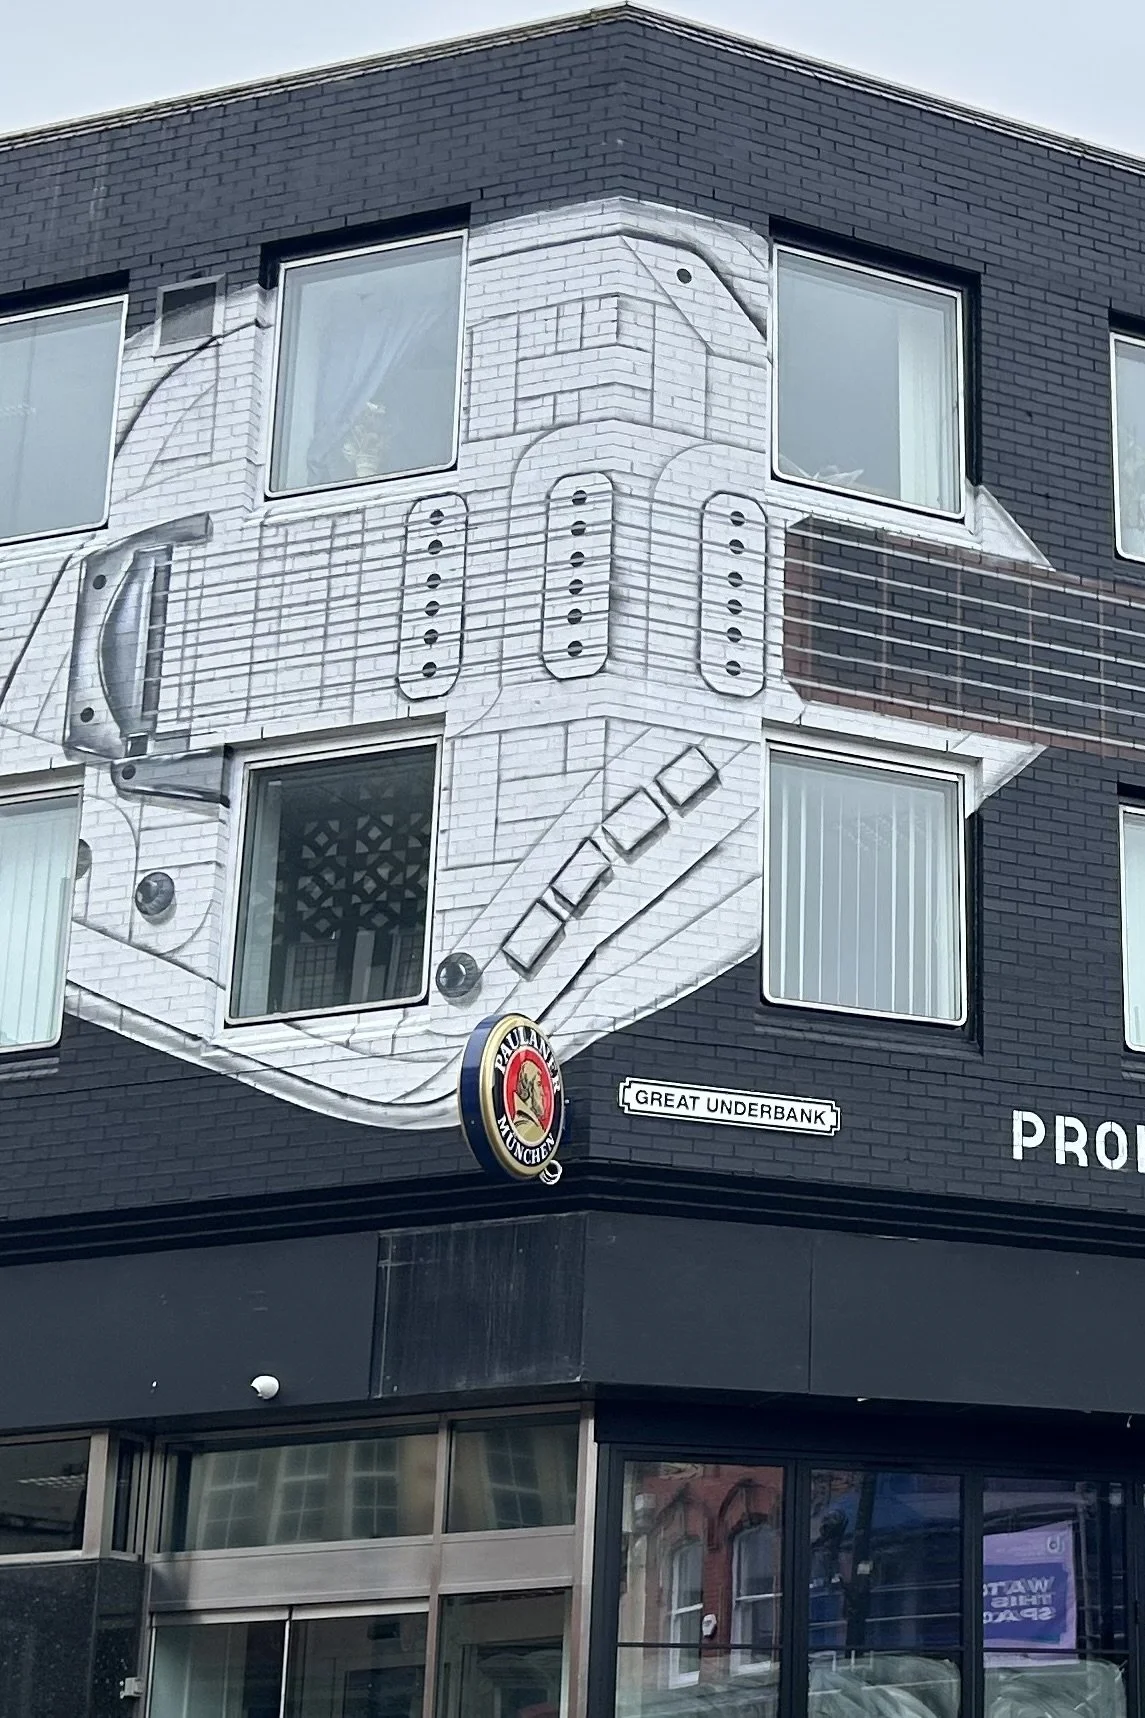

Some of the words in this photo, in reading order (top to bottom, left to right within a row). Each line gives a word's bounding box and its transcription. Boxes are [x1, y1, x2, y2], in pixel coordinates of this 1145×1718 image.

[495, 1026, 561, 1093] PAULANER
[635, 1089, 700, 1111] GREAT
[706, 1097, 827, 1125] UNDERBANK
